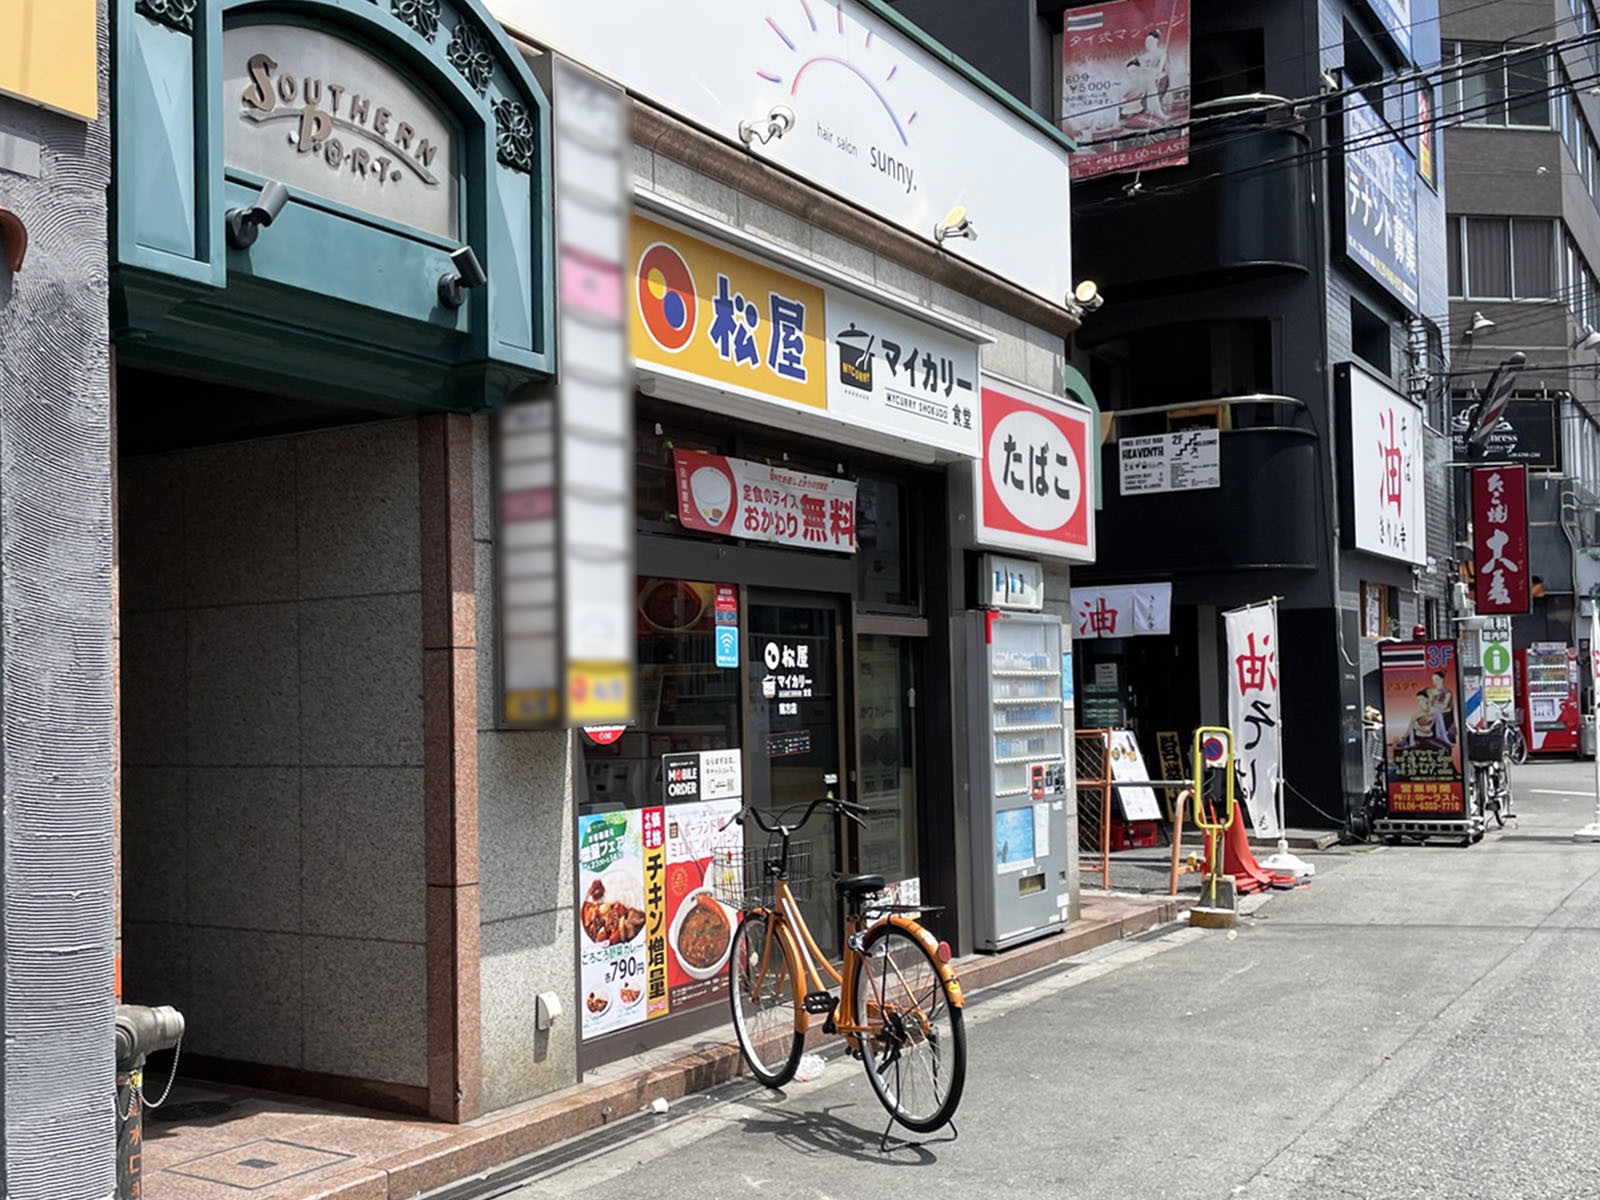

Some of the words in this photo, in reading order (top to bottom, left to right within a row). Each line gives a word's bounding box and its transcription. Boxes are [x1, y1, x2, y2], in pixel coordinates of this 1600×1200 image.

[242, 53, 438, 168] SOUTHERN
[816, 121, 834, 144] hair
[836, 136, 858, 158] salon
[709, 273, 808, 384] 松屋
[881, 338, 973, 399] マイカリー
[886, 392, 917, 411] MYCURRY
[919, 402, 949, 420] SHOKUDO
[952, 403, 972, 430] 食堂
[1002, 432, 1071, 501] たばこ
[1377, 407, 1402, 519] 油
[743, 484, 799, 510] 定食のライス
[744, 505, 799, 539] おかわり
[801, 493, 854, 547] 無料
[1079, 597, 1120, 636] 油
[782, 644, 809, 669] 松屋
[1426, 645, 1454, 669] 3F
[777, 674, 813, 689] マイカリー
[668, 767, 698, 782] MOBILE
[668, 781, 697, 797] ORDER
[645, 853, 666, 1000] チキン増量
